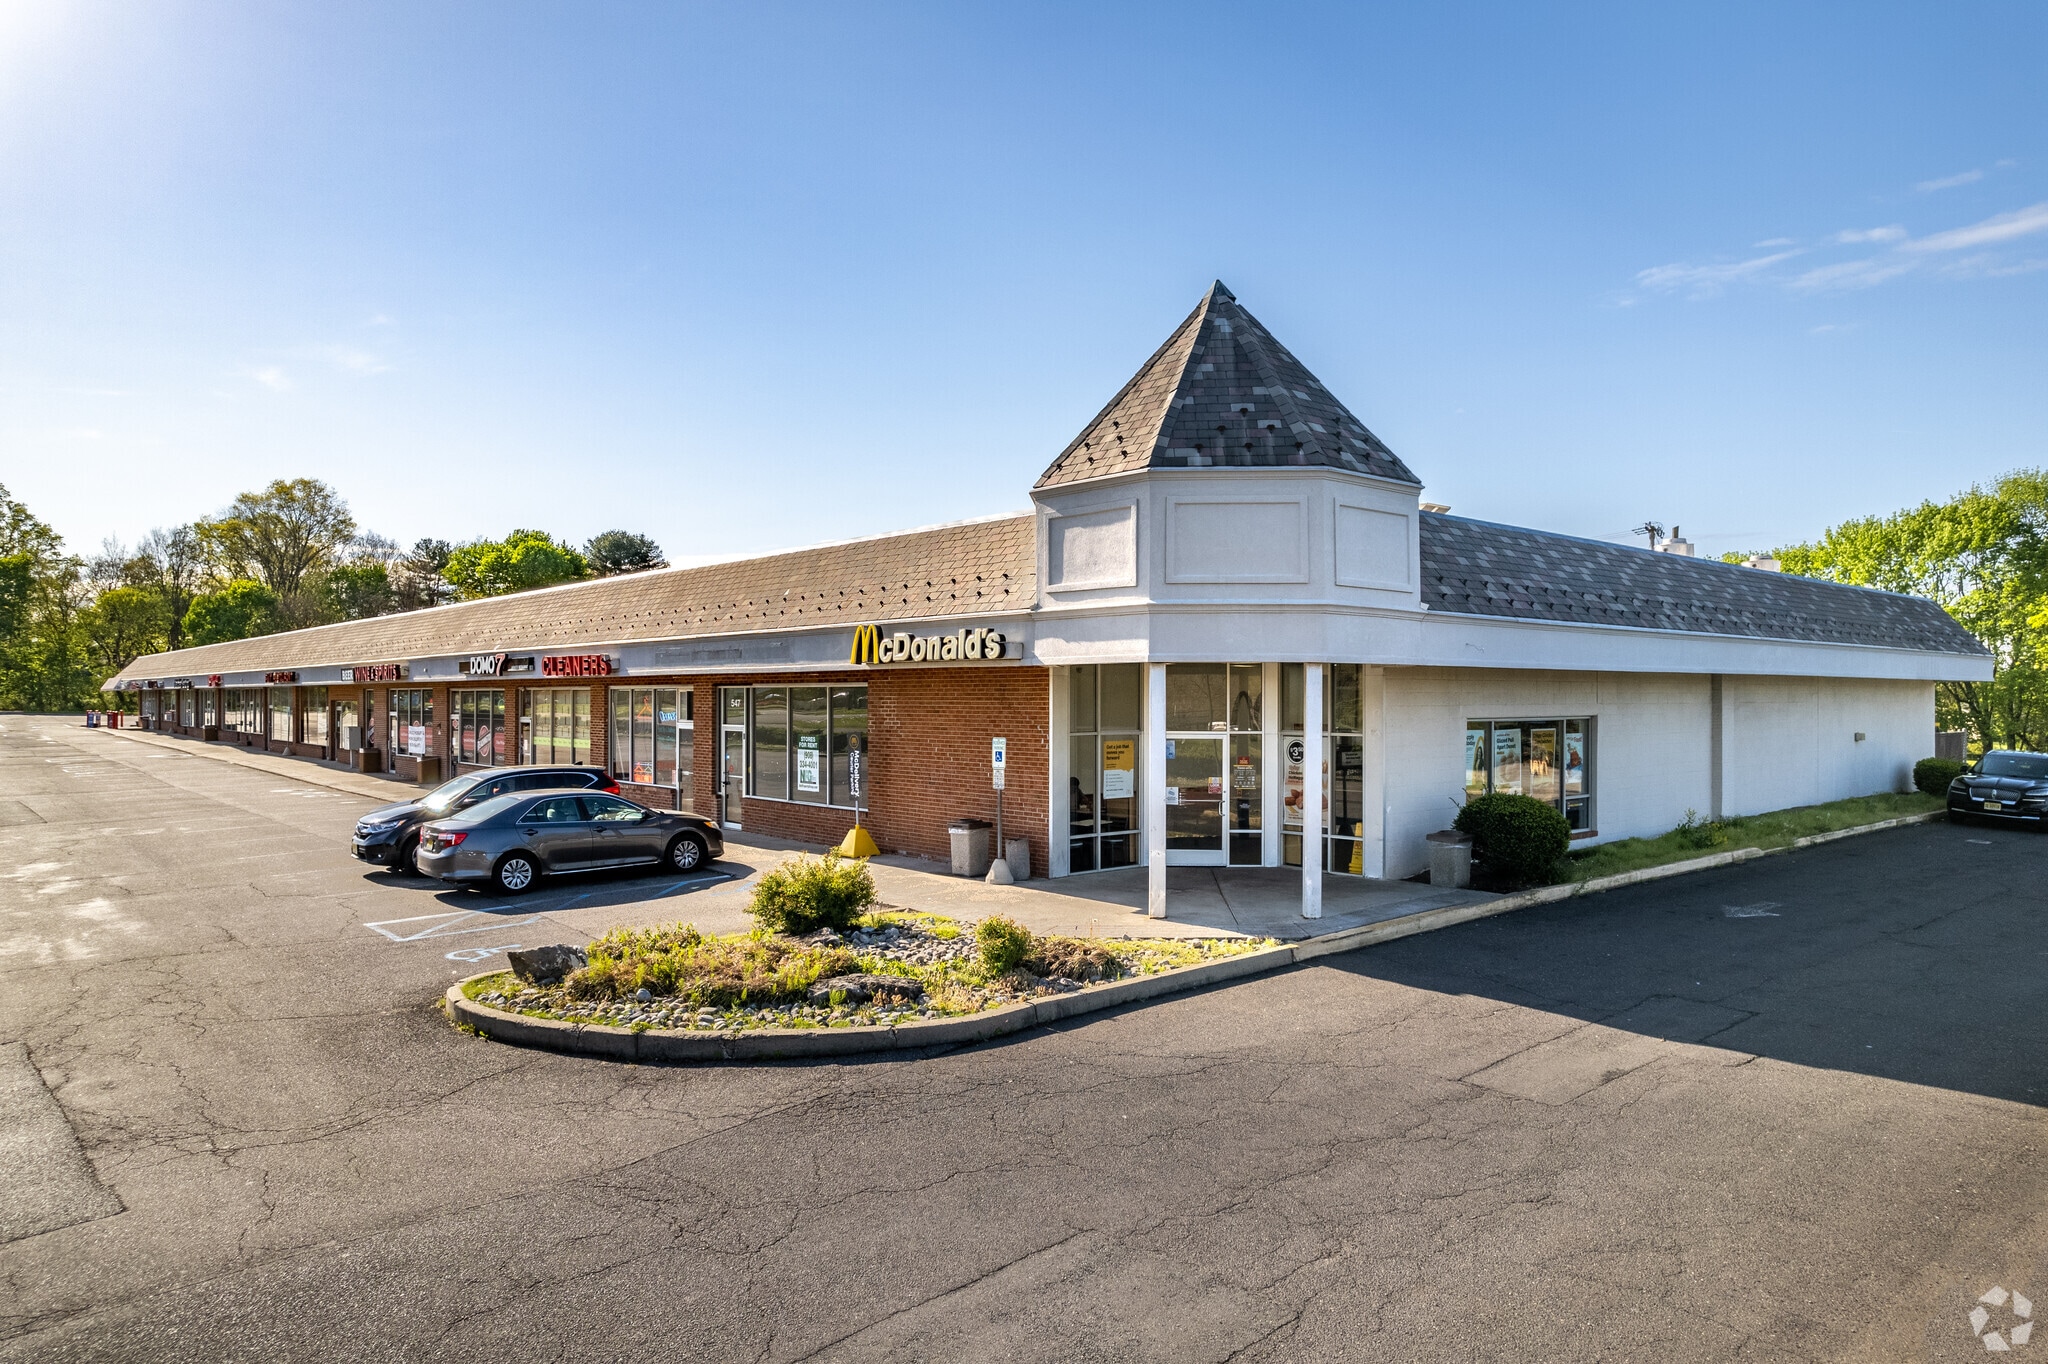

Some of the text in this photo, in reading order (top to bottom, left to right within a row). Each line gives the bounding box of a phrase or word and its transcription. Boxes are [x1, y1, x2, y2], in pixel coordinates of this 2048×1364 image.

[850, 624, 1001, 664] McDonald's
[342, 669, 354, 681] BEER
[355, 667, 370, 682] WINE
[375, 664, 397, 681] SPIRITS
[541, 654, 608, 677] CLEANERS
[731, 699, 741, 707] 547
